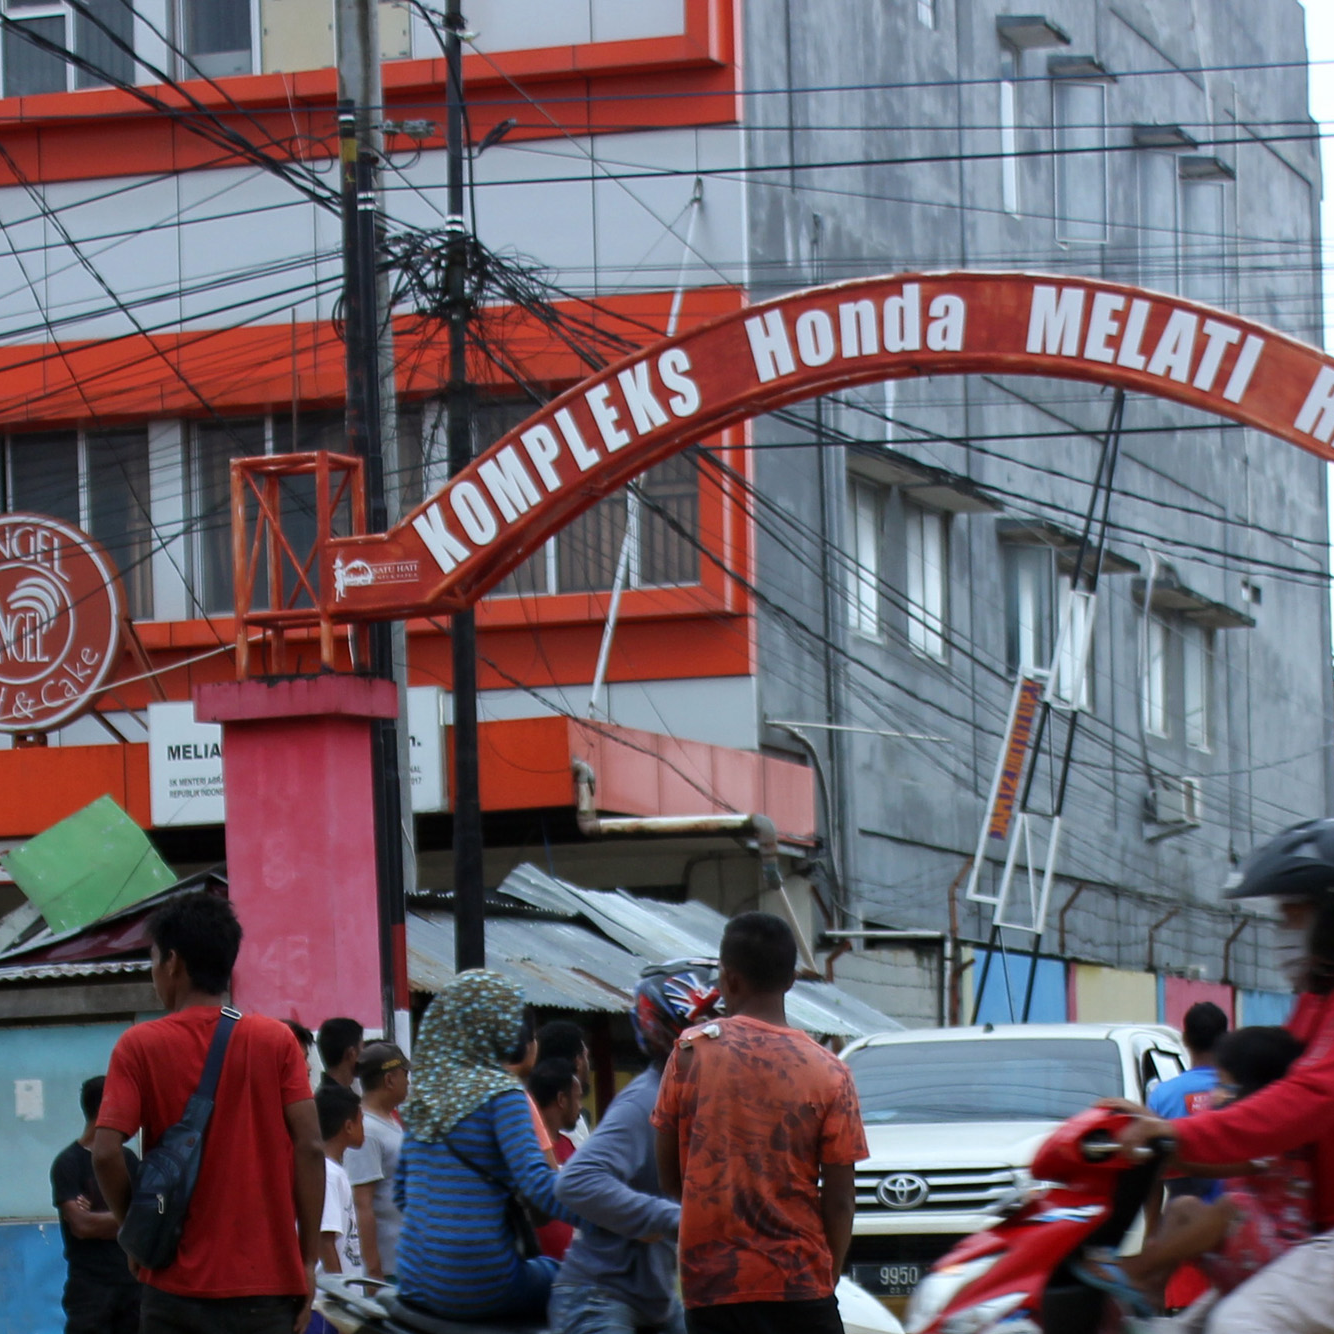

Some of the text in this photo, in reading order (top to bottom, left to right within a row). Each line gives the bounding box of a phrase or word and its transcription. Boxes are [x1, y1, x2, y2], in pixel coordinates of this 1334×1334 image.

[412, 348, 702, 575] KOMPLEKS
[744, 284, 965, 383] Honda
[1026, 285, 1265, 405] MELATI
[11, 691, 35, 719] &
[40, 646, 99, 708] Cake
[880, 1266, 919, 1286] 9950
